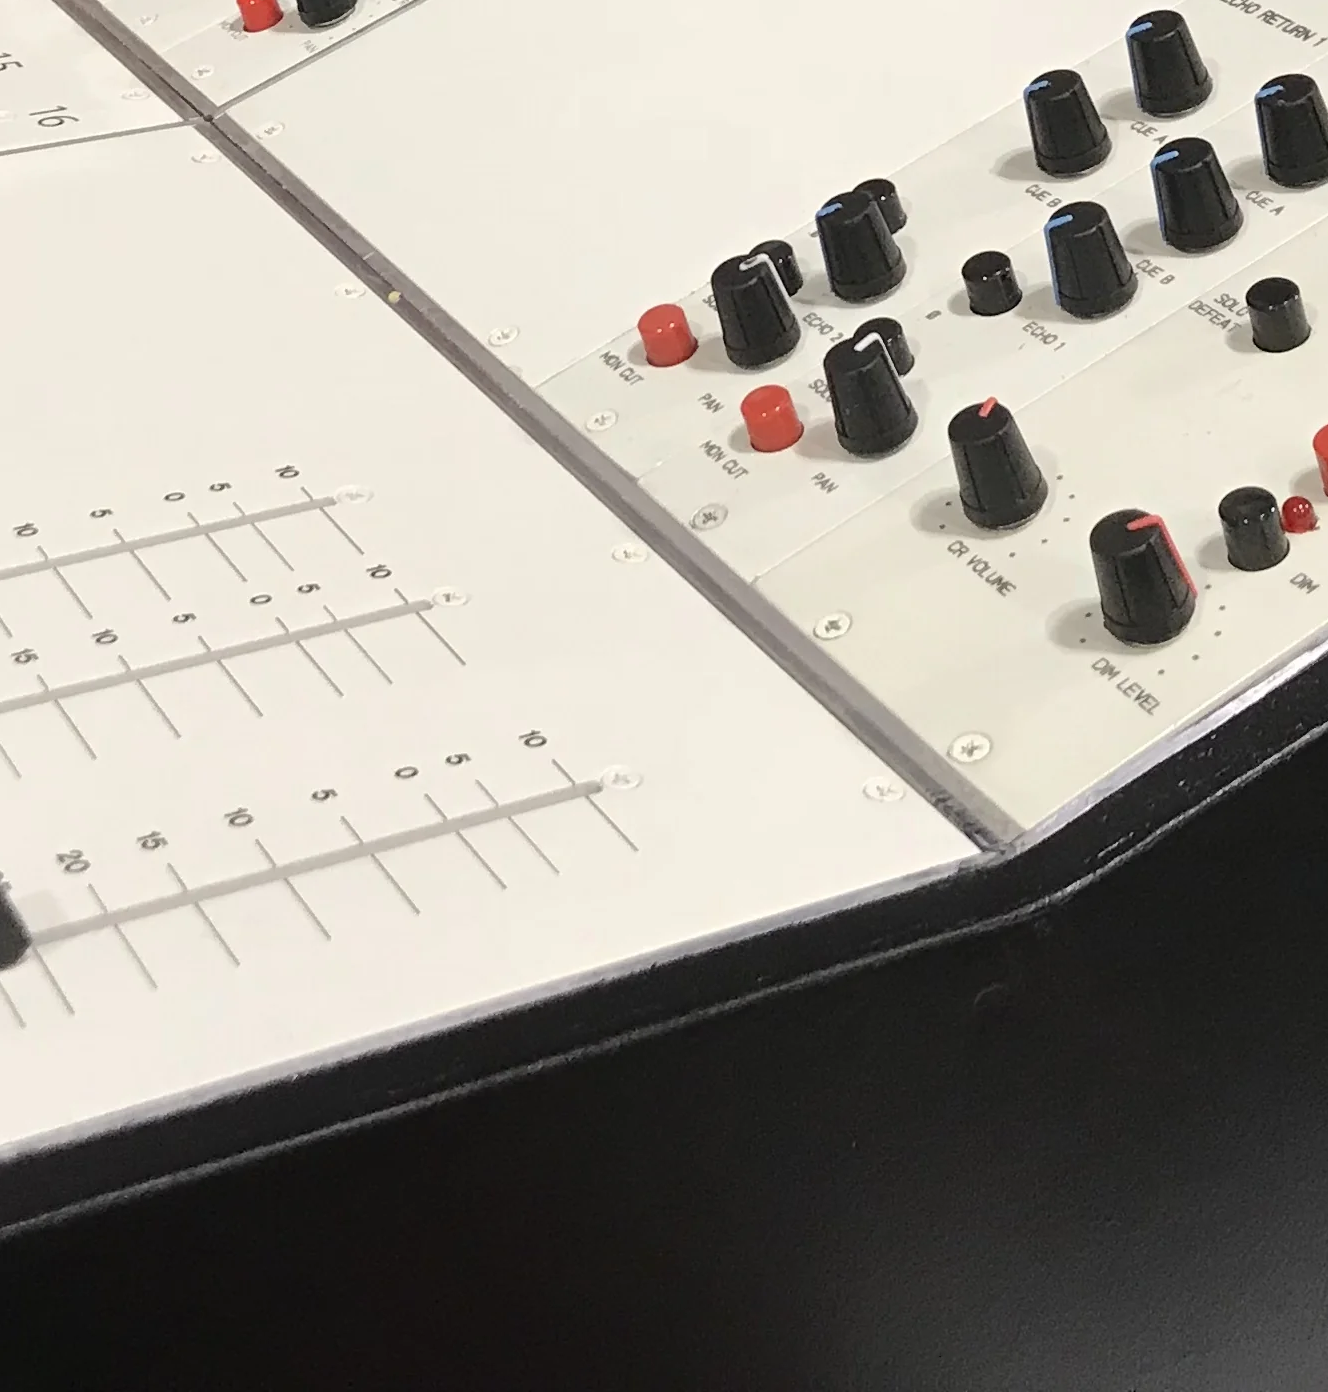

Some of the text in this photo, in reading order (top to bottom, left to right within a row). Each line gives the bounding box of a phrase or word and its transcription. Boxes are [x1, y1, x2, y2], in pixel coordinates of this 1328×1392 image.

[1257, 10, 1317, 42] RETURN
[28, 105, 80, 128] 16
[1130, 121, 1159, 138] CUE
[1025, 184, 1049, 201] CUE
[1245, 190, 1285, 216] CUE A
[1135, 259, 1175, 285] CUE B
[802, 312, 834, 335] ECHO
[1187, 299, 1242, 333] DEFEAT
[1022, 321, 1059, 345] ECHO
[599, 350, 645, 386] MON CUT
[697, 392, 725, 414] PAN
[699, 439, 750, 480] MON CUT
[810, 472, 839, 494] PAN
[12, 522, 39, 538] 10
[90, 508, 114, 519] 5
[163, 491, 185, 502] 0
[209, 482, 232, 492] 5
[275, 464, 300, 479] 10
[946, 539, 1017, 598] CR VOLUME
[1289, 571, 1322, 595] DIM
[10, 648, 38, 664] 15
[91, 628, 119, 645] 10
[172, 612, 196, 624] 5
[249, 594, 273, 605] 0
[296, 583, 321, 594] 5
[366, 564, 392, 579] 10
[1090, 656, 1162, 717] DIM LEVEL
[55, 729, 549, 875] 20 15 10 5 0 5 10
